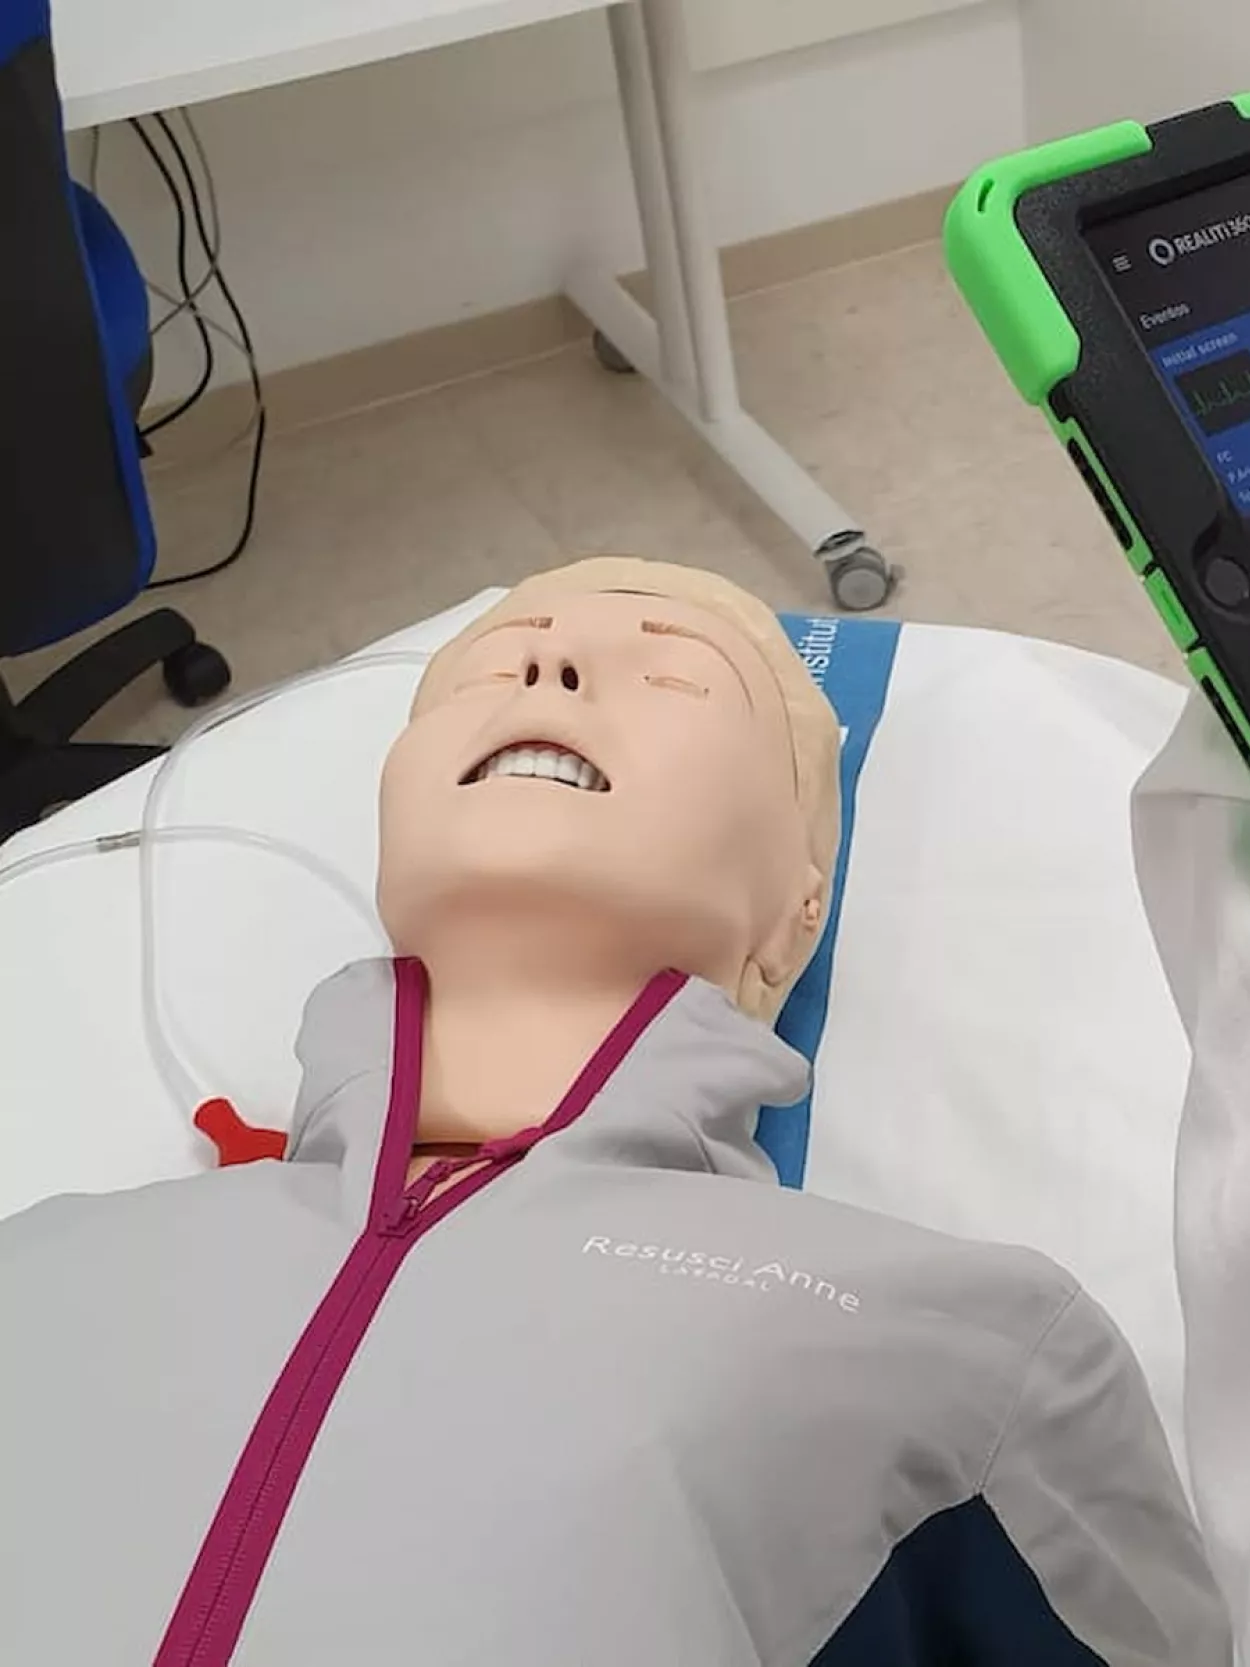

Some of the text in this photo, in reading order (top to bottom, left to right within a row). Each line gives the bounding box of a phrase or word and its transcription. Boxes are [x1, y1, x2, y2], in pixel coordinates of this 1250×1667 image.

[1140, 302, 1190, 331] Eventos
[1161, 331, 1239, 368] Initial screen
[800, 617, 841, 689] nstitut
[582, 1235, 861, 1314] Resusci Anne
